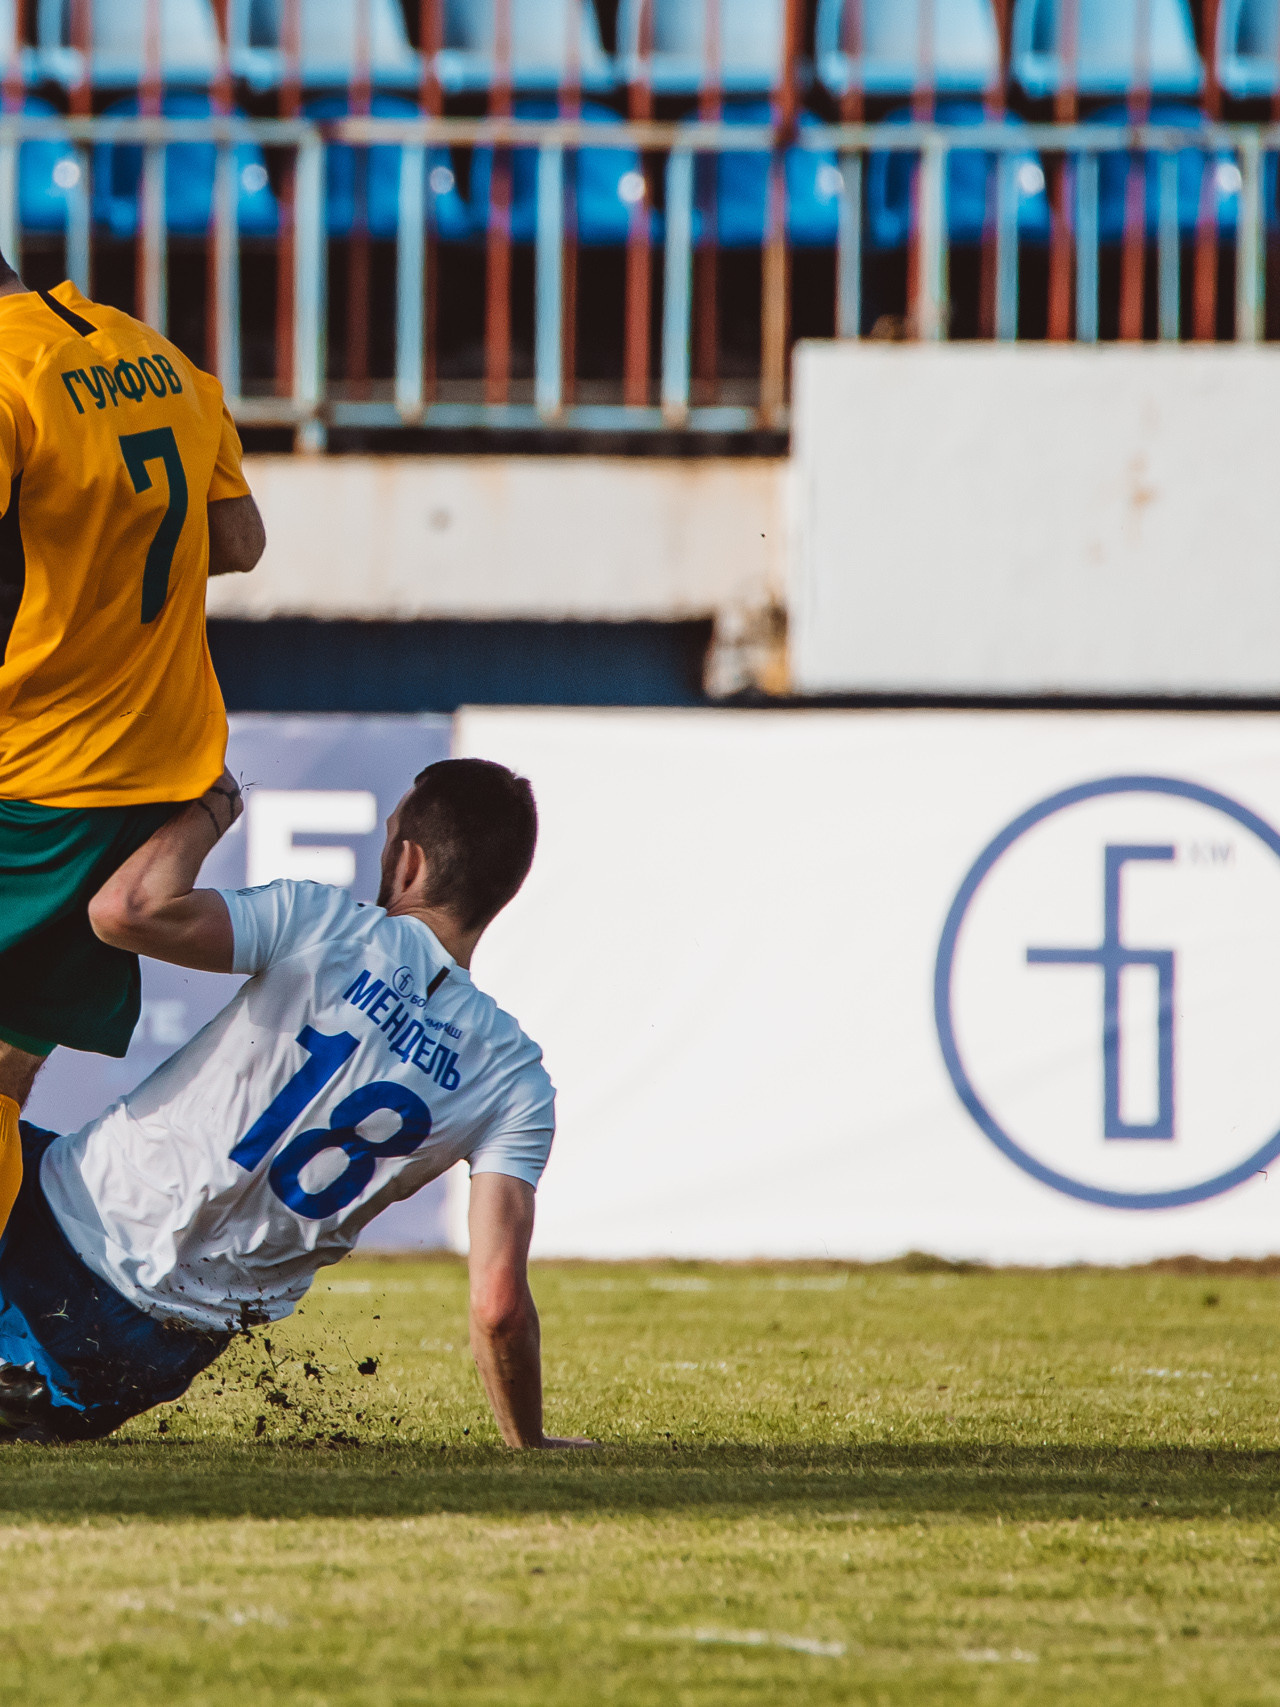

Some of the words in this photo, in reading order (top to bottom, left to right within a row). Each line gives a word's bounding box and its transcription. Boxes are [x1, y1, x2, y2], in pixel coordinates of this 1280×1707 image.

[61, 353, 183, 414] ГУРФОВ
[118, 426, 189, 624] 7
[342, 969, 461, 1091] МЕНДЕЛЬ
[228, 1024, 432, 1220] 18
